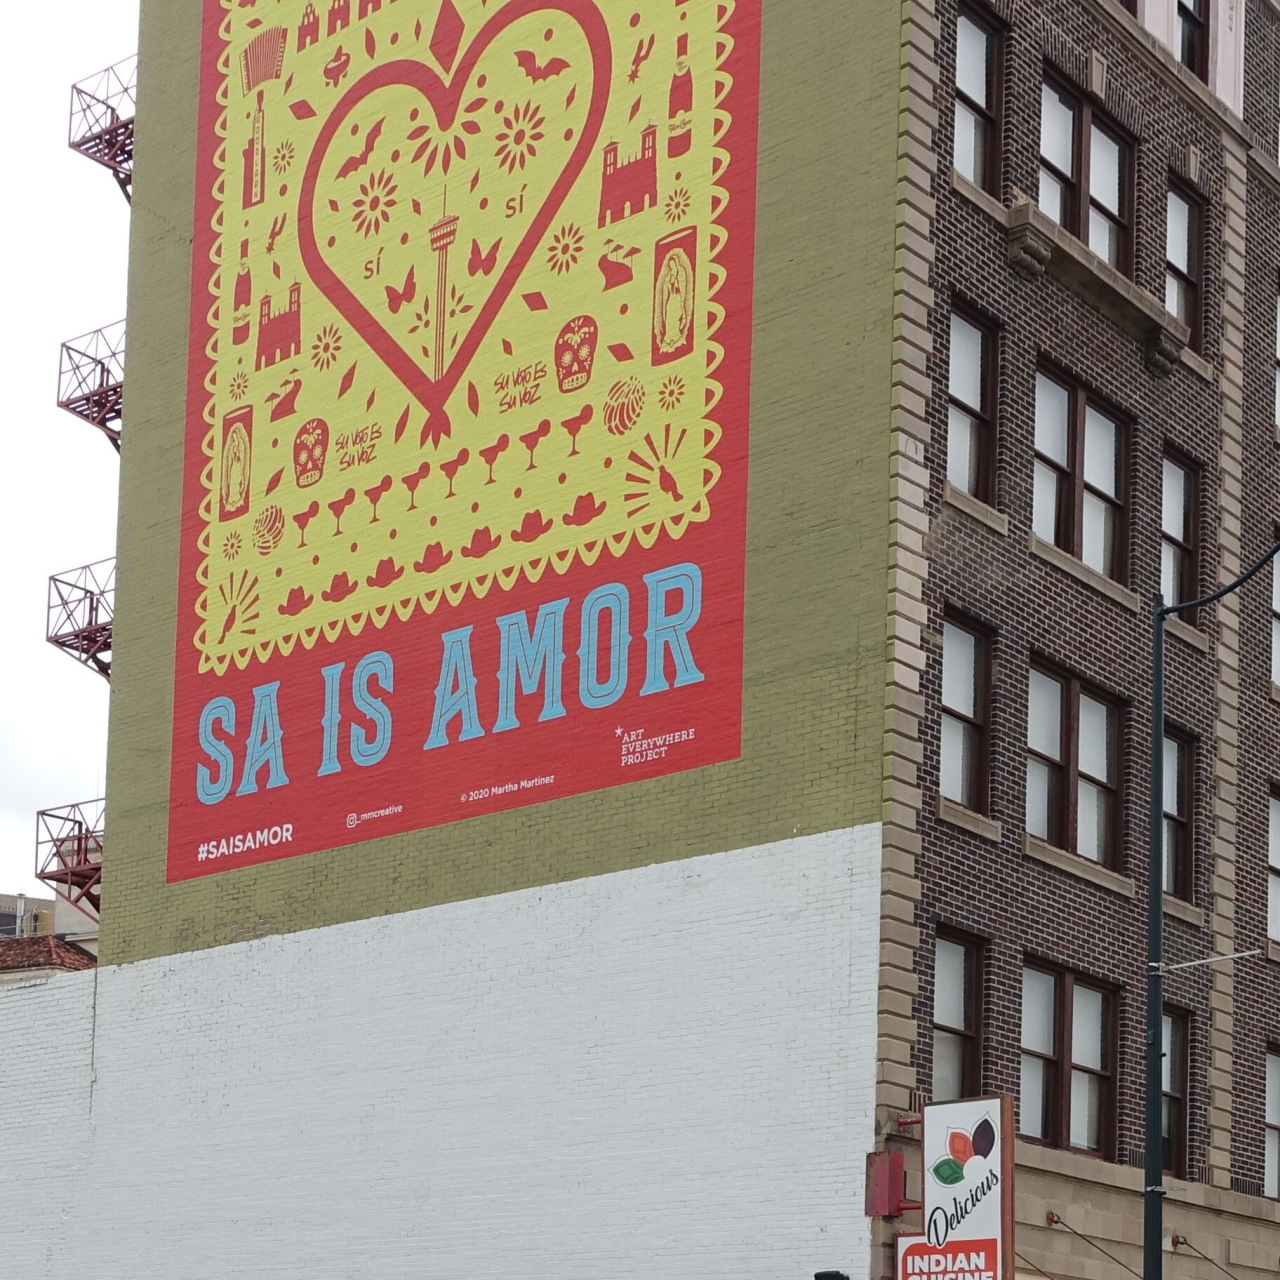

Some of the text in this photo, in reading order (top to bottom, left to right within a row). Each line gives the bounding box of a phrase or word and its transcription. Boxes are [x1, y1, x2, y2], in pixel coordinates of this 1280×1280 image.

[197, 561, 705, 805] SA IS AMOR
[621, 728, 695, 754] EVERYWHERE
[621, 747, 668, 767] PROJECT
[469, 787, 490, 802] 2020
[491, 781, 519, 796] Martha
[520, 774, 555, 791] Martinez
[197, 823, 293, 861] #SAISAMOR
[927, 1168, 999, 1247] Delicious
[906, 1252, 985, 1273] INDIAN
